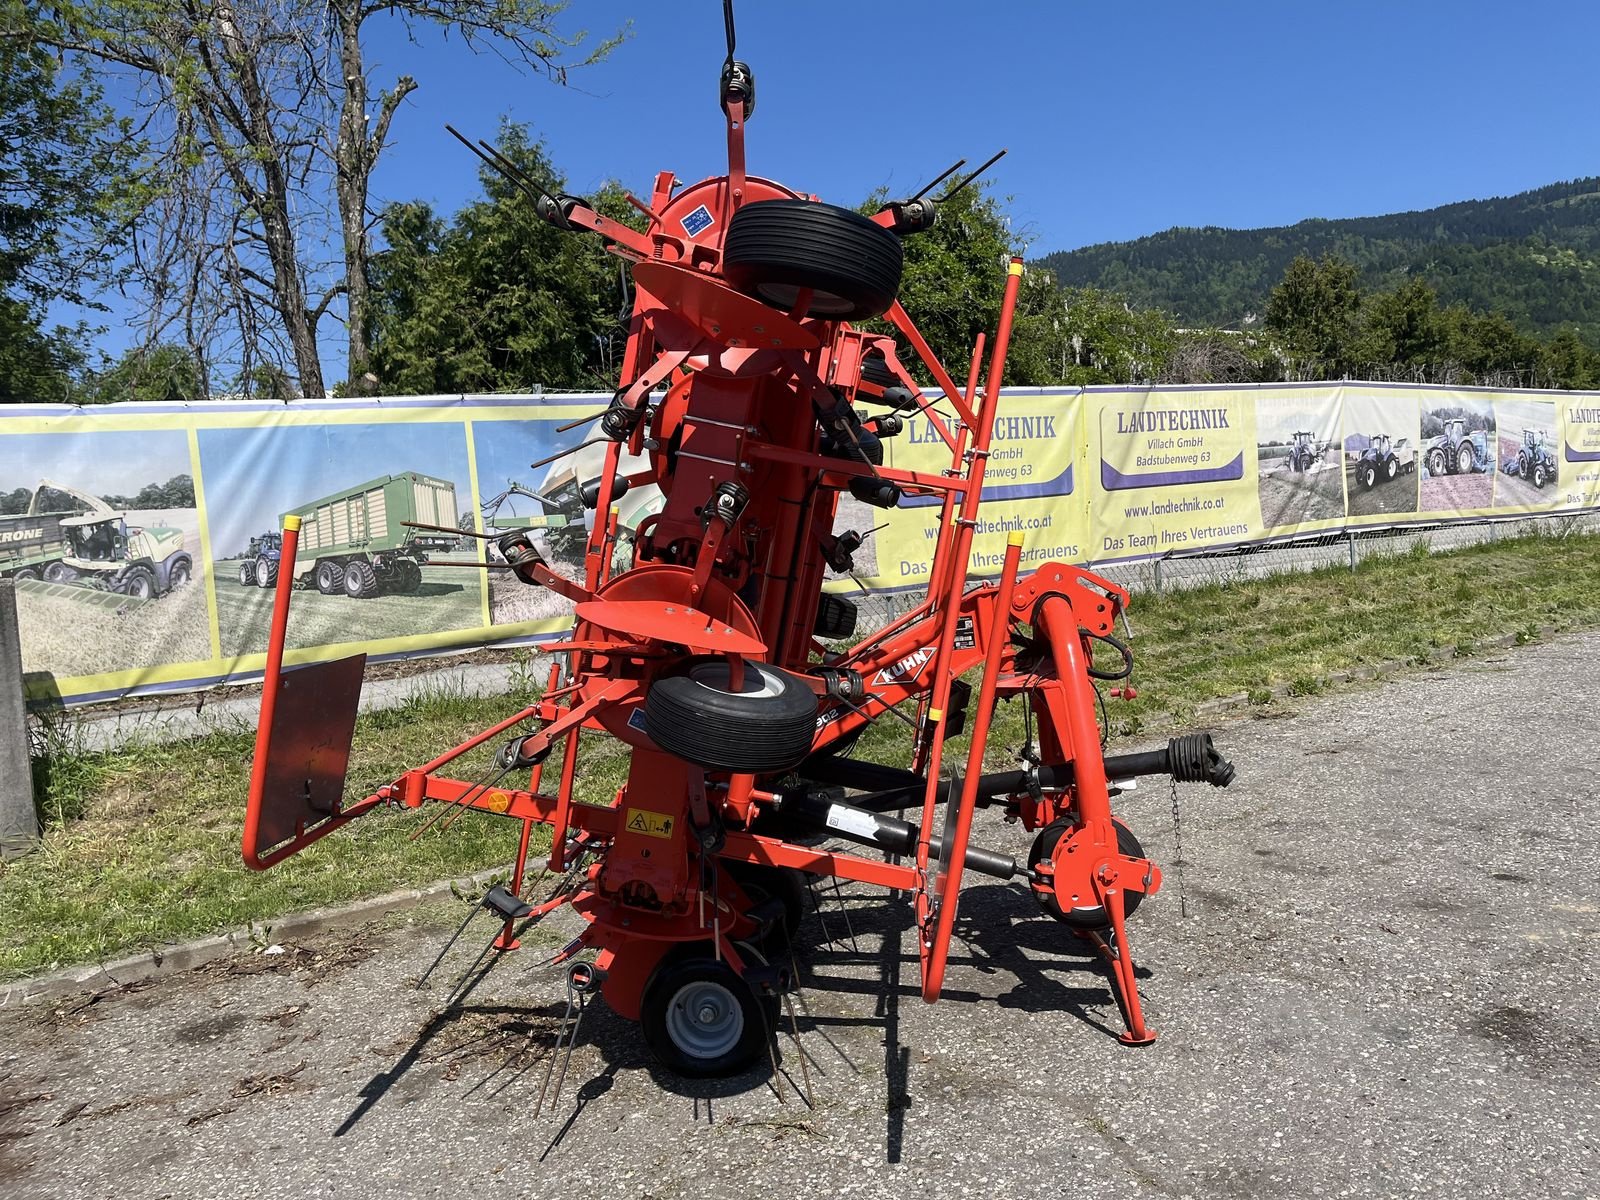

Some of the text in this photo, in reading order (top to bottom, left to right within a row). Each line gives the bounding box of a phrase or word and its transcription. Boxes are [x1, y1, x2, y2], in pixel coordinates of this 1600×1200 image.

[1117, 409, 1230, 434] LANDTECHNIK
[1147, 437, 1203, 450] Villach GmbH
[991, 447, 1023, 460] GmbH
[1136, 451, 1211, 466] Badstubenweg 63
[1020, 464, 1033, 476] 63
[1124, 497, 1225, 518] www.landtechnik.co.at
[0, 528, 43, 543] RONE
[1103, 523, 1248, 551] Das Team Ihres Vertrauens
[1019, 545, 1078, 562] ertrauens
[900, 560, 928, 576] Das
[881, 649, 928, 683] KUHN
